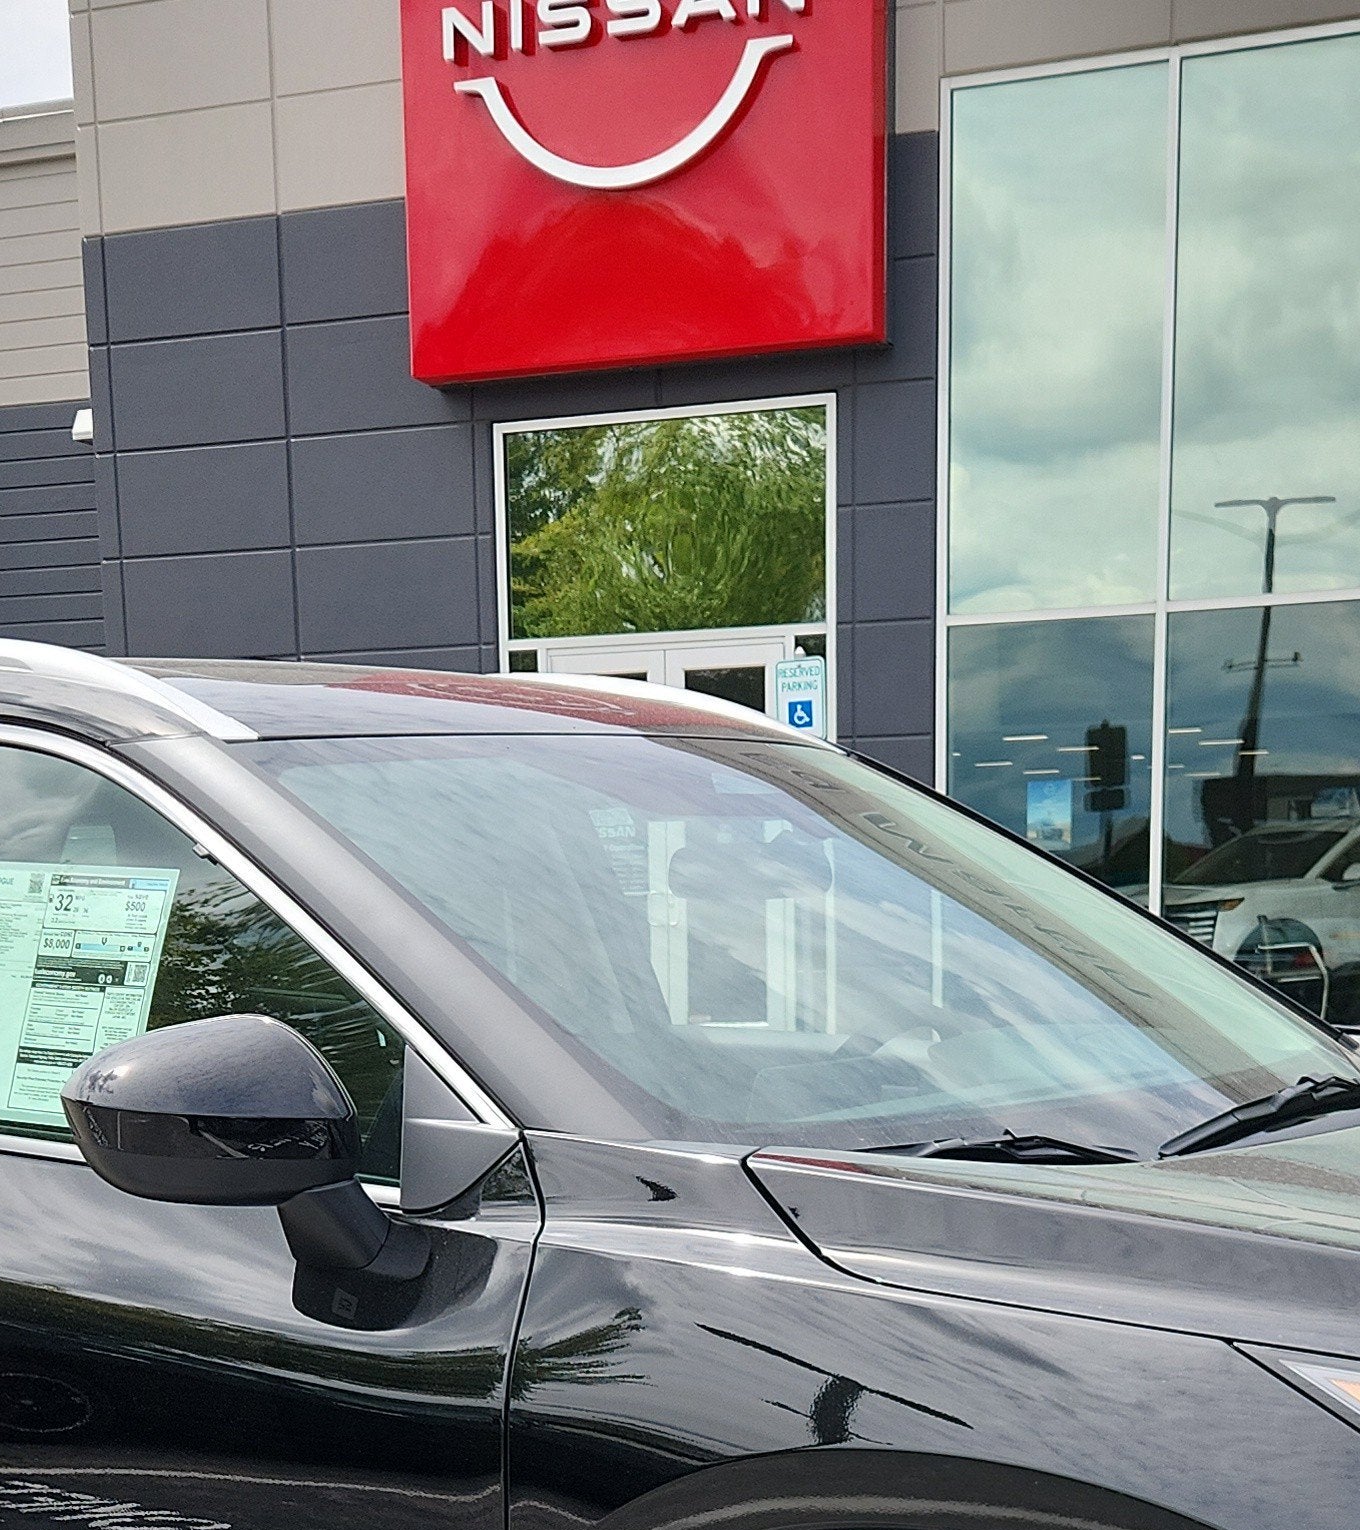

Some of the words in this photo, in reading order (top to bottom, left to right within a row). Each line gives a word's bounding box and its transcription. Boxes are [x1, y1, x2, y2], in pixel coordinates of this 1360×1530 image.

[778, 665, 821, 678] RESERVED
[781, 679, 819, 692] PARKING
[55, 893, 74, 912] 32
